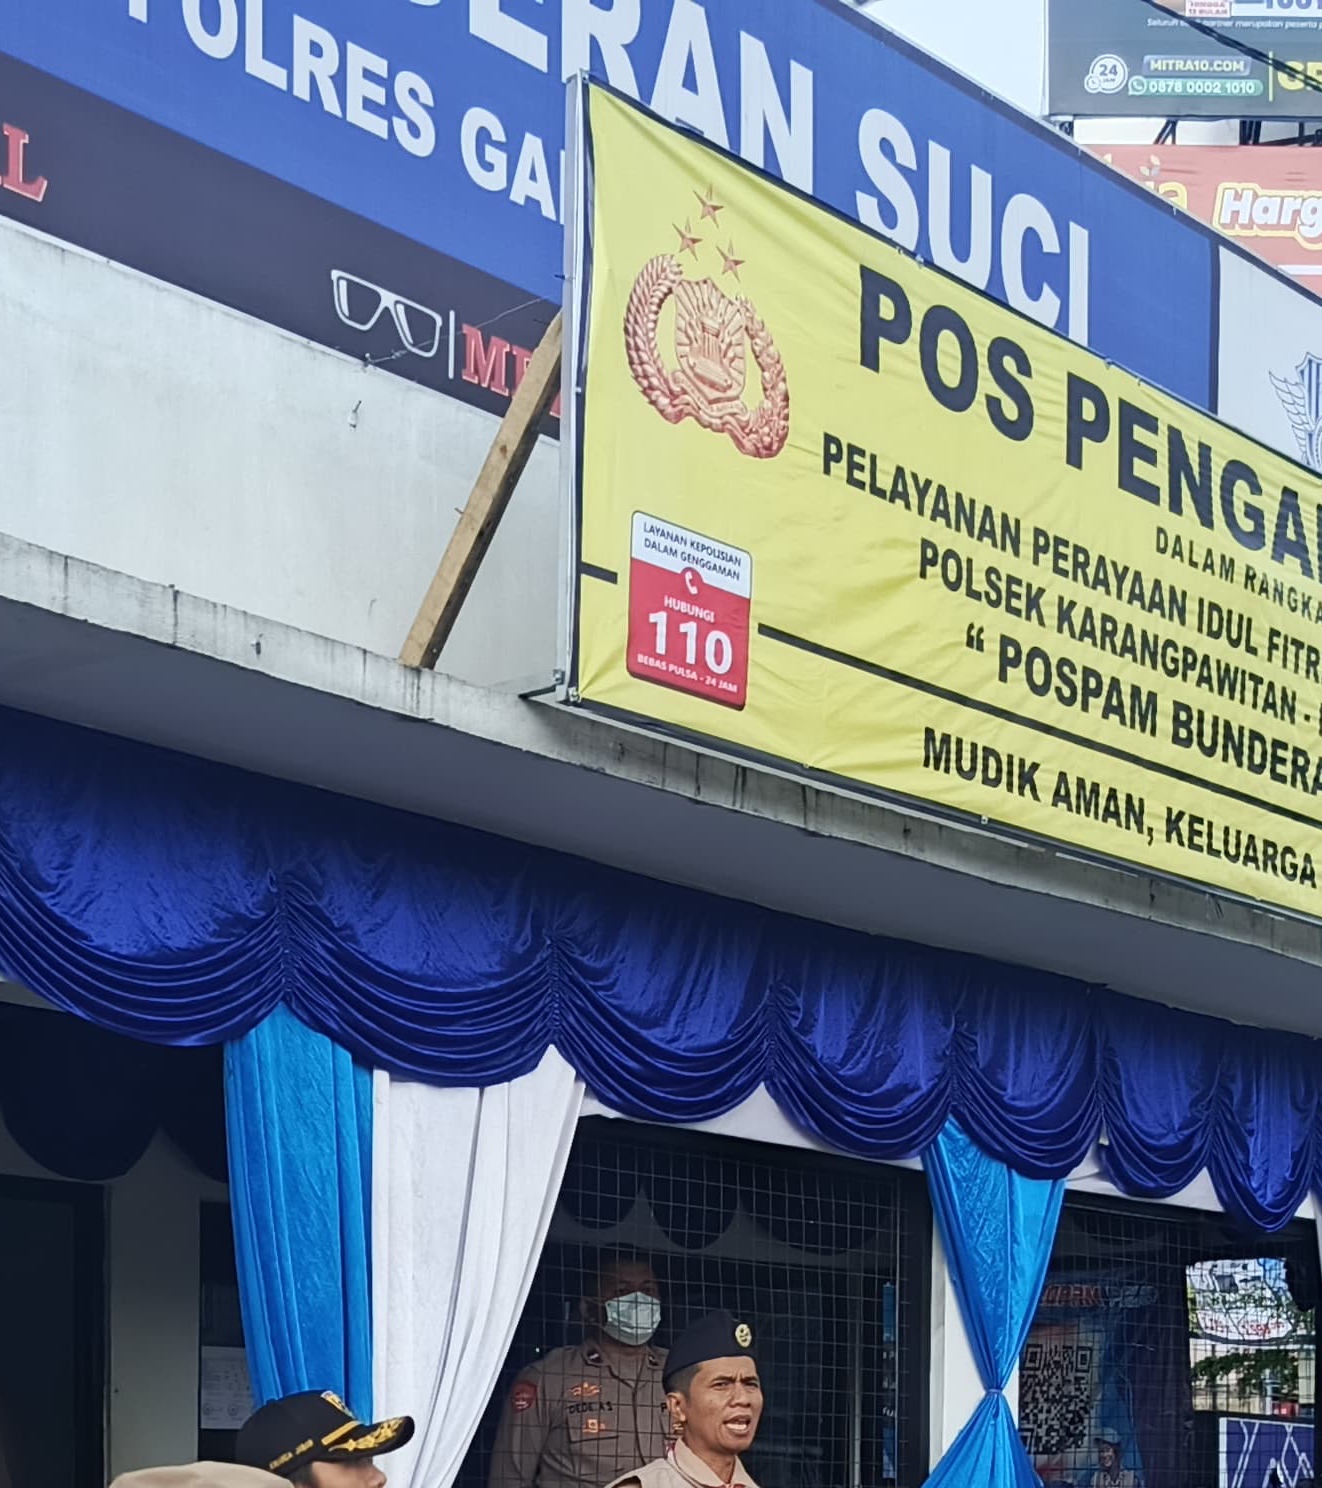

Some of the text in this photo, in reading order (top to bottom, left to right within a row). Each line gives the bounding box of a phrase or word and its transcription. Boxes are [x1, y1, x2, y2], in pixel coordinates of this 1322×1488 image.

[1099, 64, 1118, 76] 24
[1149, 60, 1245, 72] MITRA10.COM
[1149, 81, 1255, 93] 0878 0002 1010
[856, 108, 1089, 347] SUCI
[859, 264, 1035, 441] POS
[643, 521, 742, 567] LAYANAN KEPOLISIAN
[644, 537, 741, 582] DALAM GENGGAMAN
[823, 432, 1021, 559] PELAYANAN
[1032, 527, 1187, 626] PERAYAAN
[1197, 597, 1259, 656] IDUL
[1156, 525, 1236, 583] DALAM
[664, 595, 715, 623] HUBUNGI
[919, 538, 1046, 628] POLSEK
[1056, 595, 1297, 724] KARANGPAWITAN
[648, 611, 733, 675] 110
[637, 653, 667, 671] BEBAS
[668, 663, 698, 681] PULSA
[705, 675, 717, 686] 24
[718, 681, 738, 694] JAM
[998, 634, 1158, 737] POSPAM
[923, 726, 1041, 802] MUDIK
[1051, 771, 1154, 847] AMAN,
[1165, 806, 1317, 889] KELUARGA
